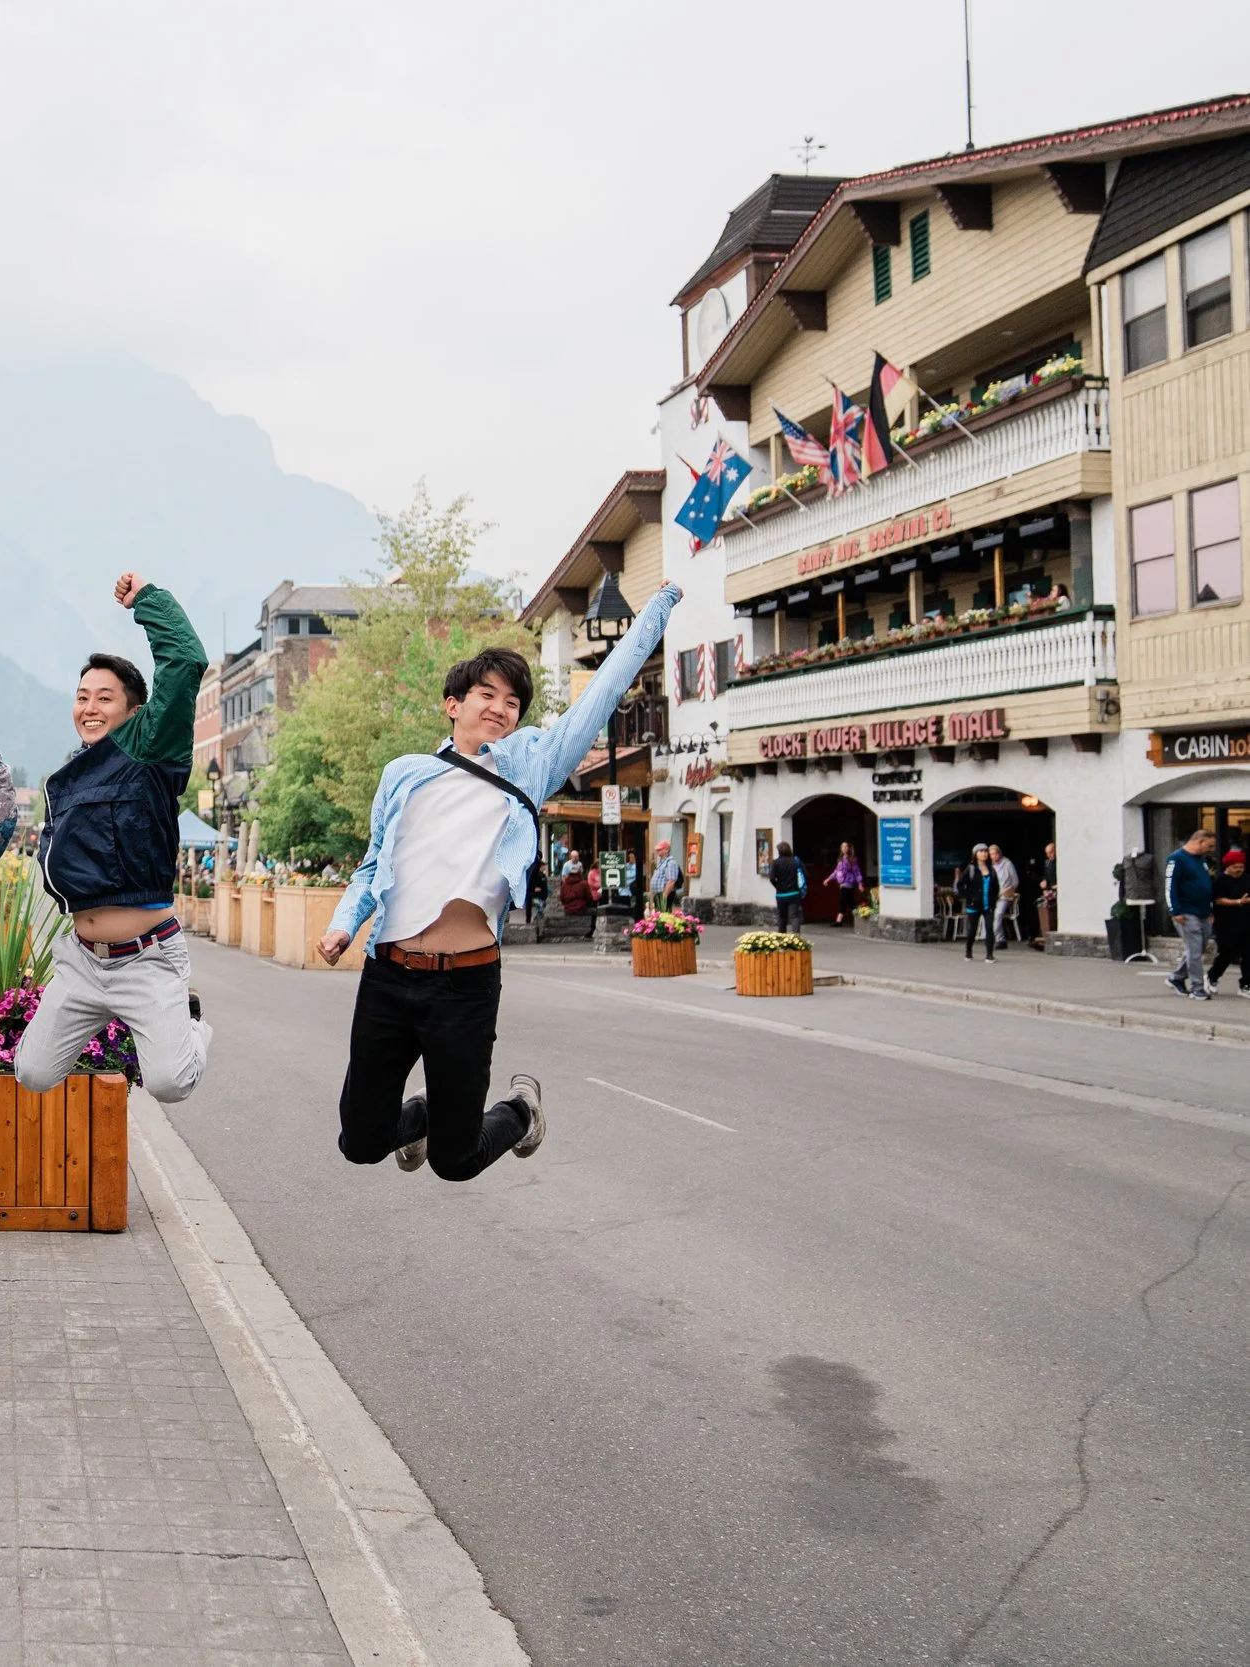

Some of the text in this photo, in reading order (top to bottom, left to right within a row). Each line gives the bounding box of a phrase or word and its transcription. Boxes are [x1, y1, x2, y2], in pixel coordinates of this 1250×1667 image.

[797, 544, 833, 576] BANFF
[868, 513, 929, 552] BREWING
[758, 708, 1008, 758] CLOCK TOWER VILLAGE MALL
[1174, 734, 1250, 760] CABIN10
